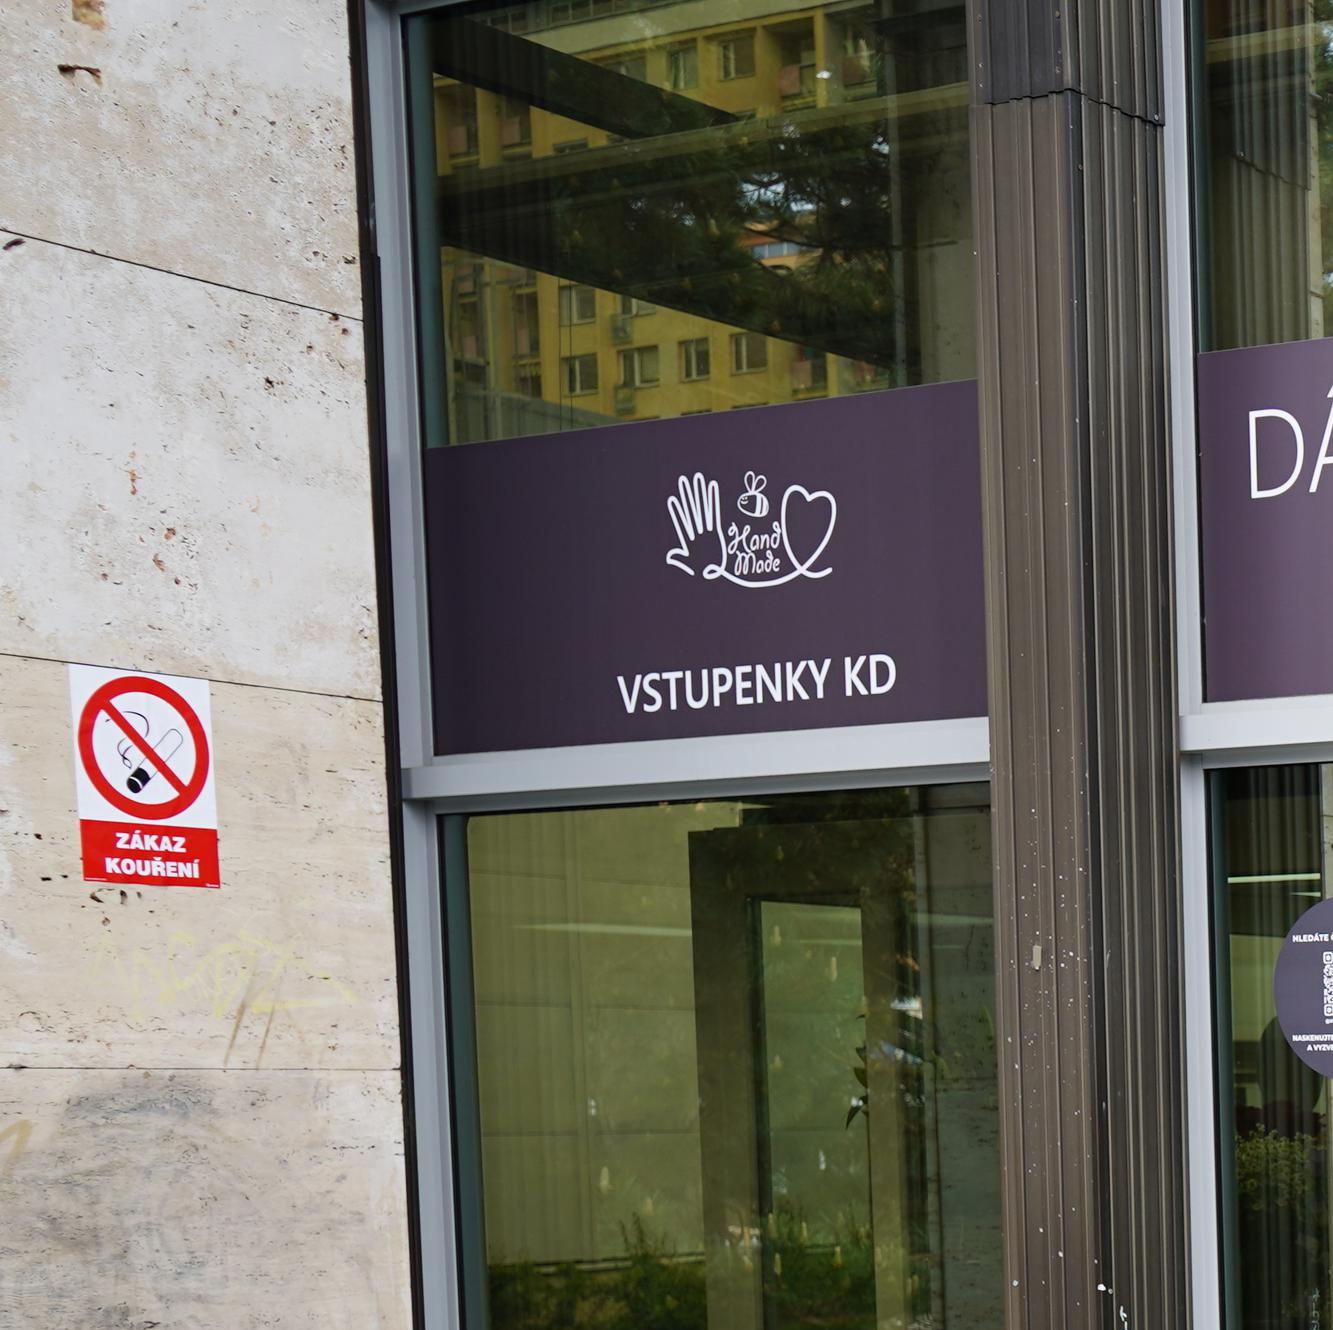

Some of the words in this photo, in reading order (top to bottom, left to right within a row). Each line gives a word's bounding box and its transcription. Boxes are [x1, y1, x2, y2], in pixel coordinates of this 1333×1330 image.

[728, 521, 781, 554] Hand
[734, 550, 780, 575] Made
[617, 658, 831, 714] VSTUPENKY
[844, 654, 897, 696] KD
[115, 830, 186, 853] ZÁKAZ
[105, 857, 199, 878] KOUŘENÍ
[1292, 932, 1329, 943] HLEDÁTE
